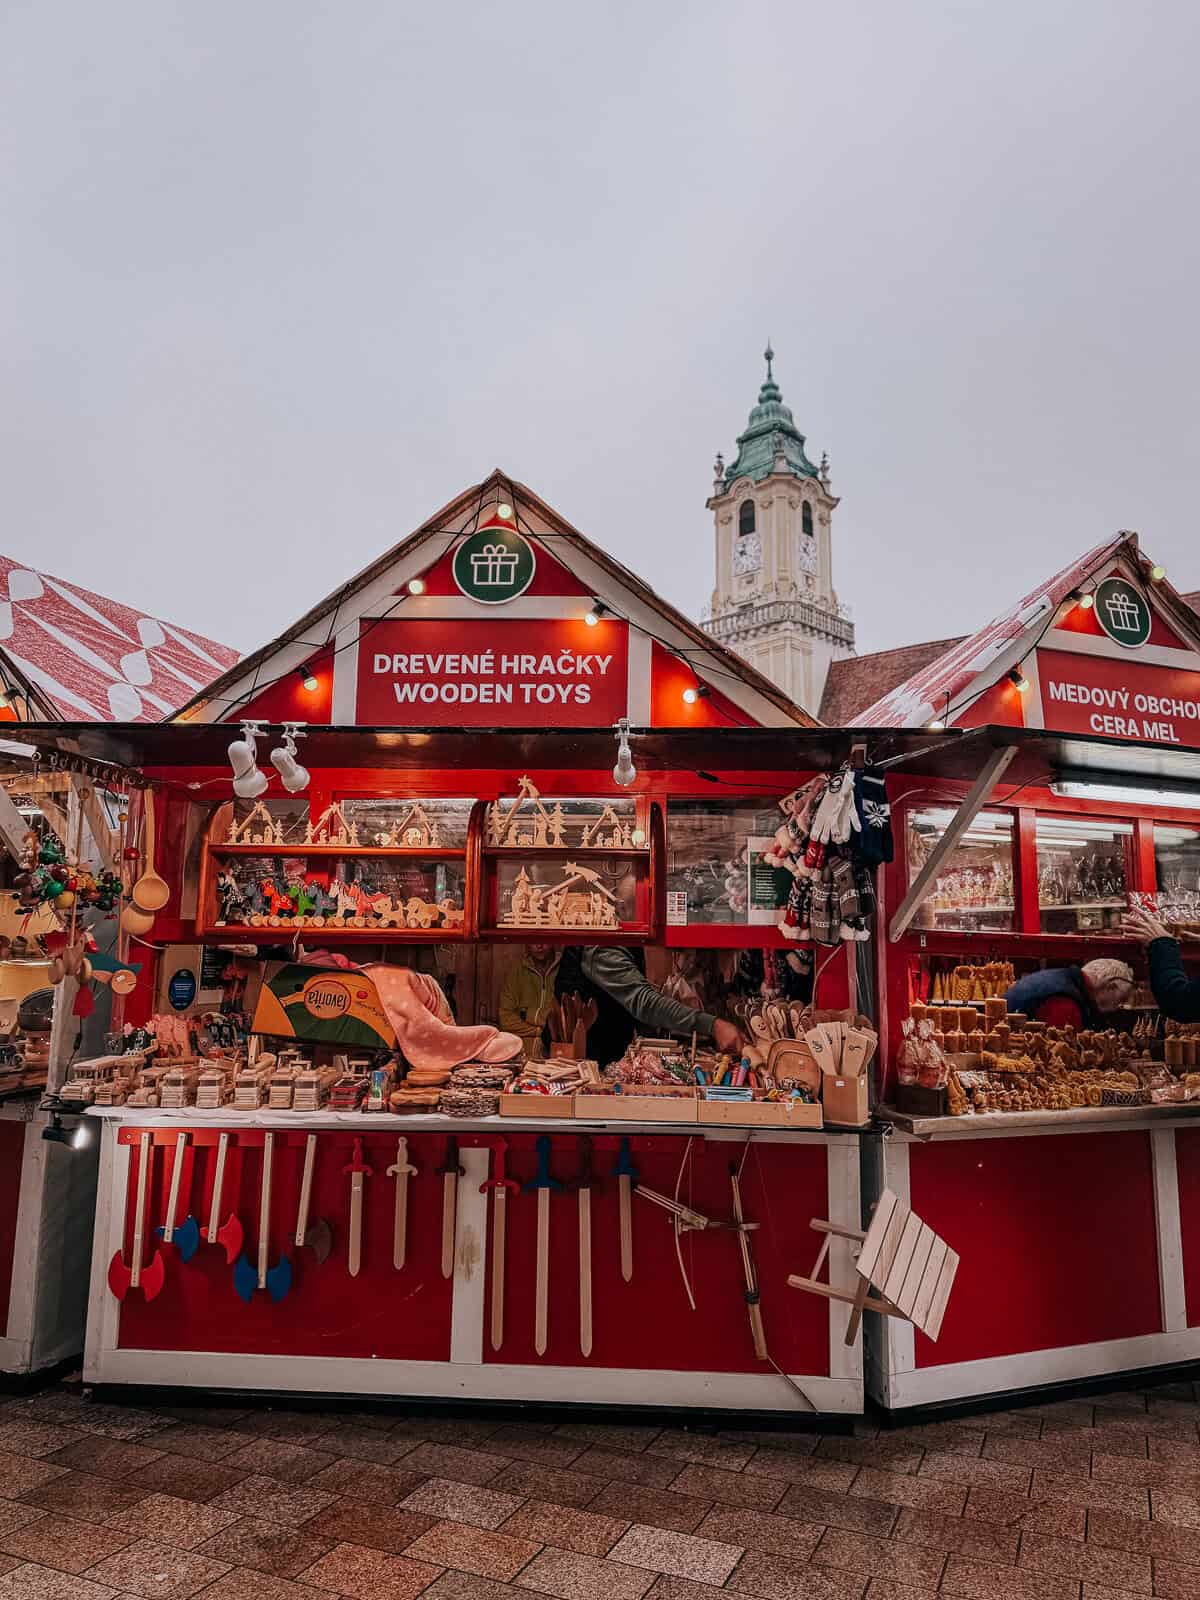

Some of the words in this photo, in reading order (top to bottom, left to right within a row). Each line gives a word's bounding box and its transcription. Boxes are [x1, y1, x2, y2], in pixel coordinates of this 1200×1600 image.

[373, 649, 495, 675] DREVENÉ
[501, 649, 613, 675] HRAČKY
[393, 682, 514, 704] WOODEN
[519, 683, 592, 704] TOYS
[1048, 681, 1130, 710] MEDOVÝ
[1089, 713, 1141, 737] CERA
[1143, 719, 1180, 743] MEL
